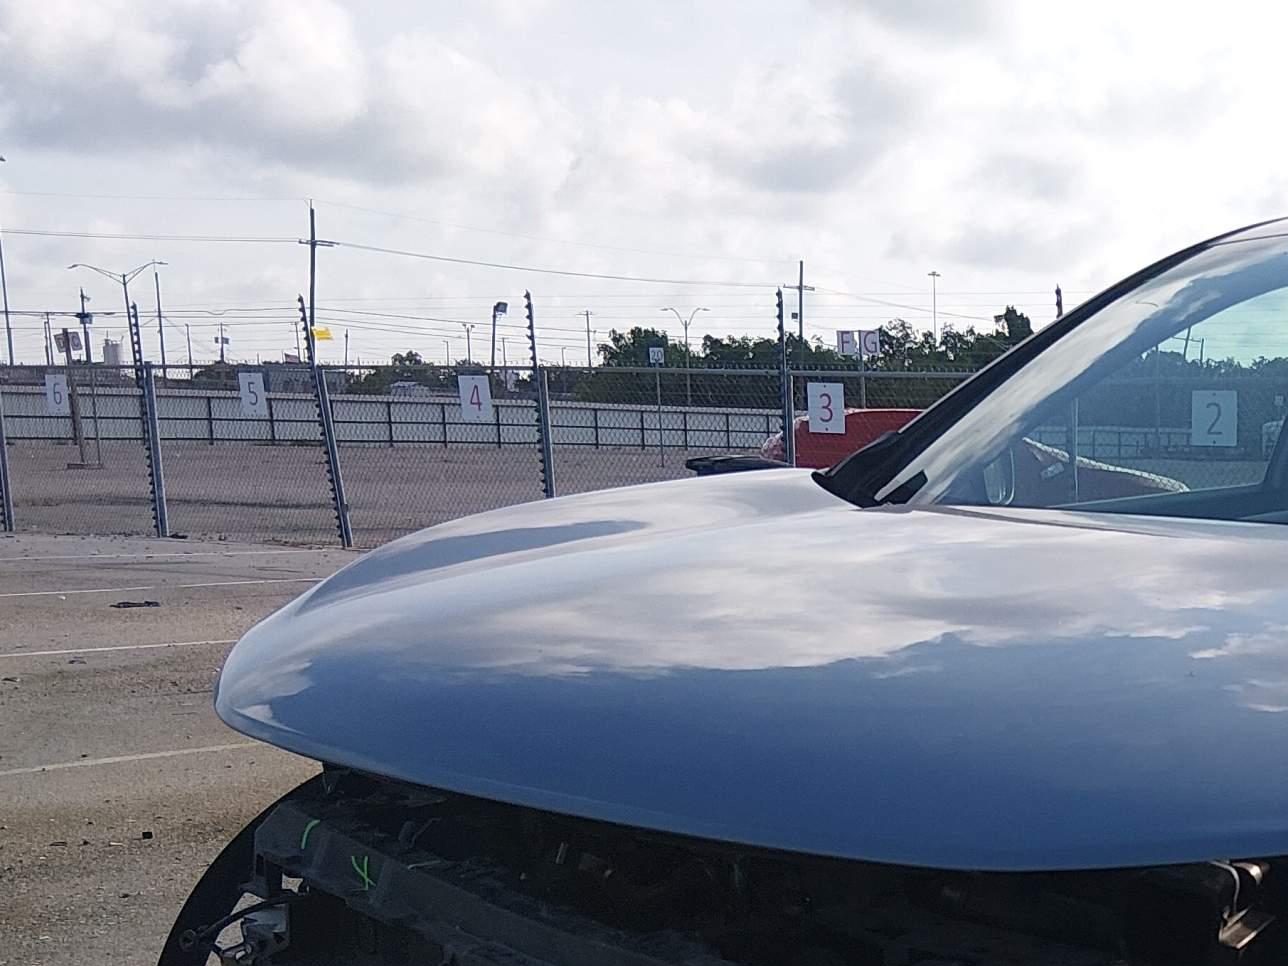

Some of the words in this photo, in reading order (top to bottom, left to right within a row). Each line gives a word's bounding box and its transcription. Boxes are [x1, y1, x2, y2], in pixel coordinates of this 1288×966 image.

[840, 331, 851, 353] F
[863, 331, 878, 353] G
[52, 382, 63, 405] 6
[246, 381, 258, 406] 5
[469, 384, 482, 411] 4
[818, 392, 834, 423] 3
[1205, 401, 1223, 435] 2
